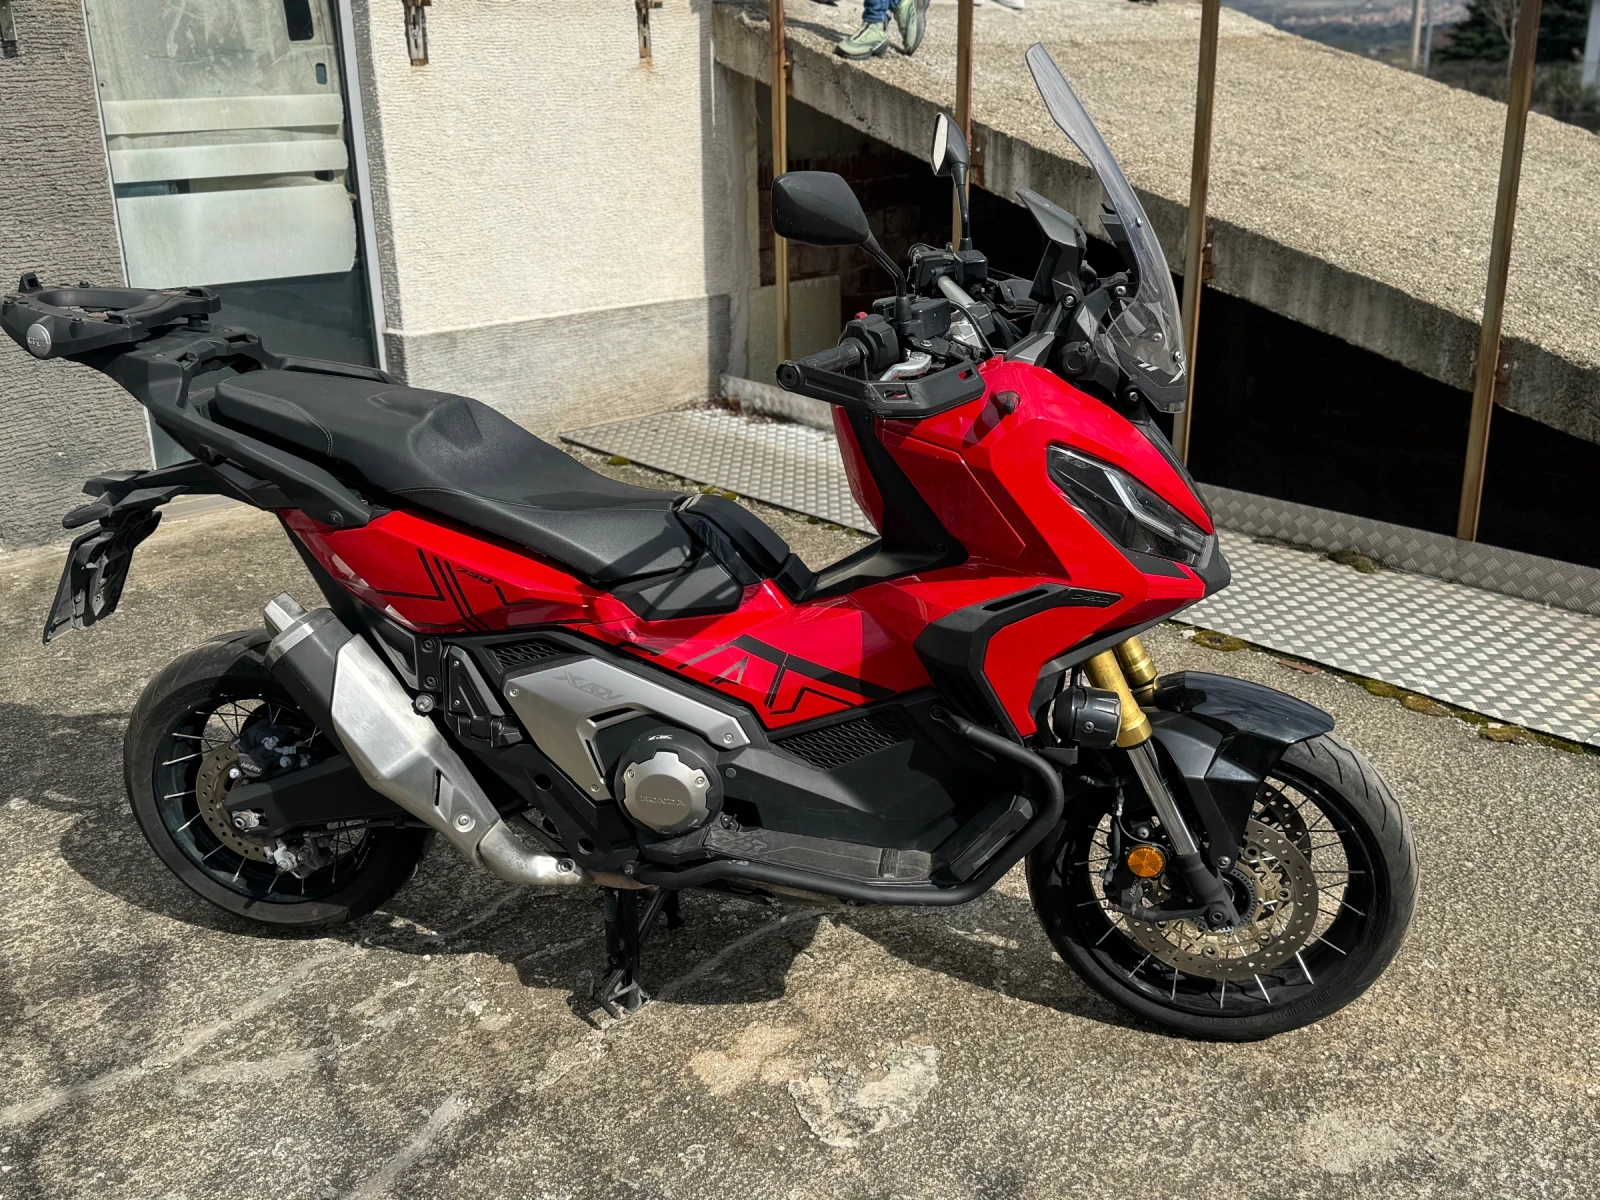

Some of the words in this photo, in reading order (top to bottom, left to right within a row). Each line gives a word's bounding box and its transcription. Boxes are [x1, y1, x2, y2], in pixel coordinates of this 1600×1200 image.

[456, 566, 494, 584] 750
[552, 670, 625, 701] X-ADV
[640, 795, 686, 806] HONDA
